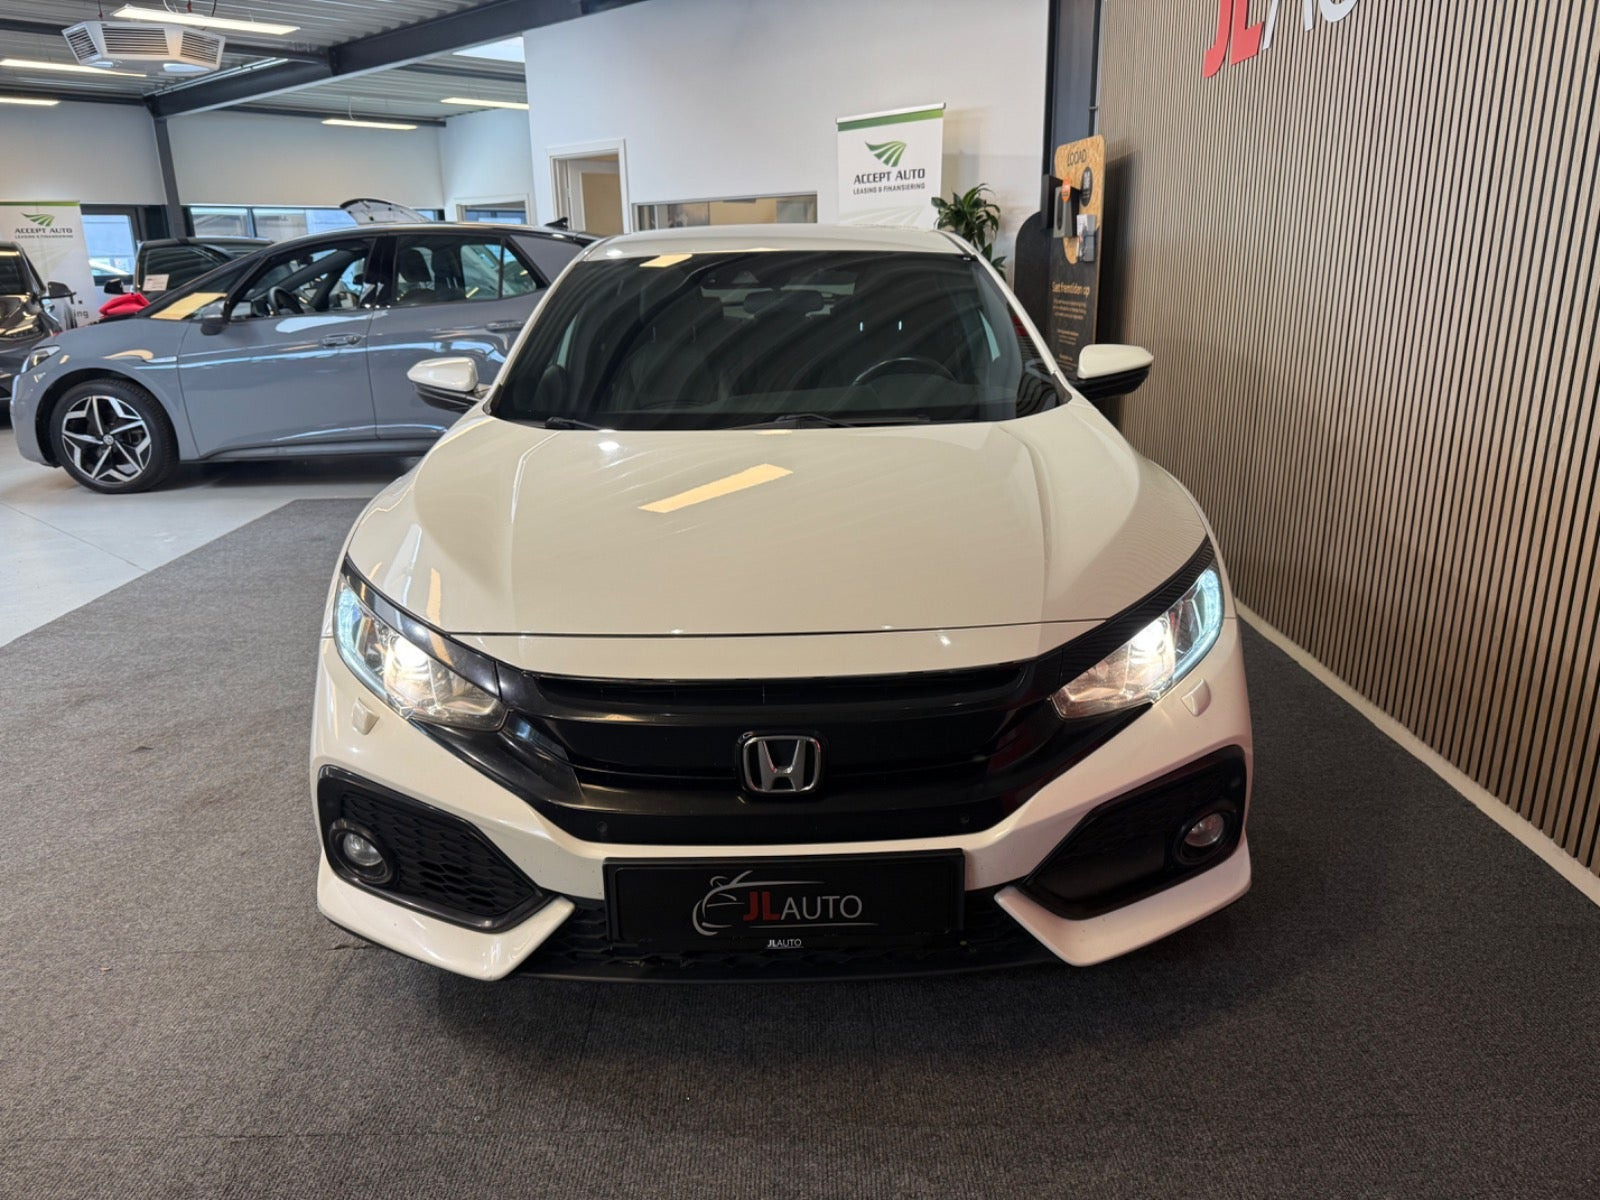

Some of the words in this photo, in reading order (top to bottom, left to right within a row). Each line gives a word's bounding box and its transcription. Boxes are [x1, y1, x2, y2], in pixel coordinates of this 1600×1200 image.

[853, 171, 892, 185] ACCEPT
[895, 168, 926, 181] AUTO
[853, 186, 877, 195] LEASING
[883, 182, 926, 192] FINANSIERING
